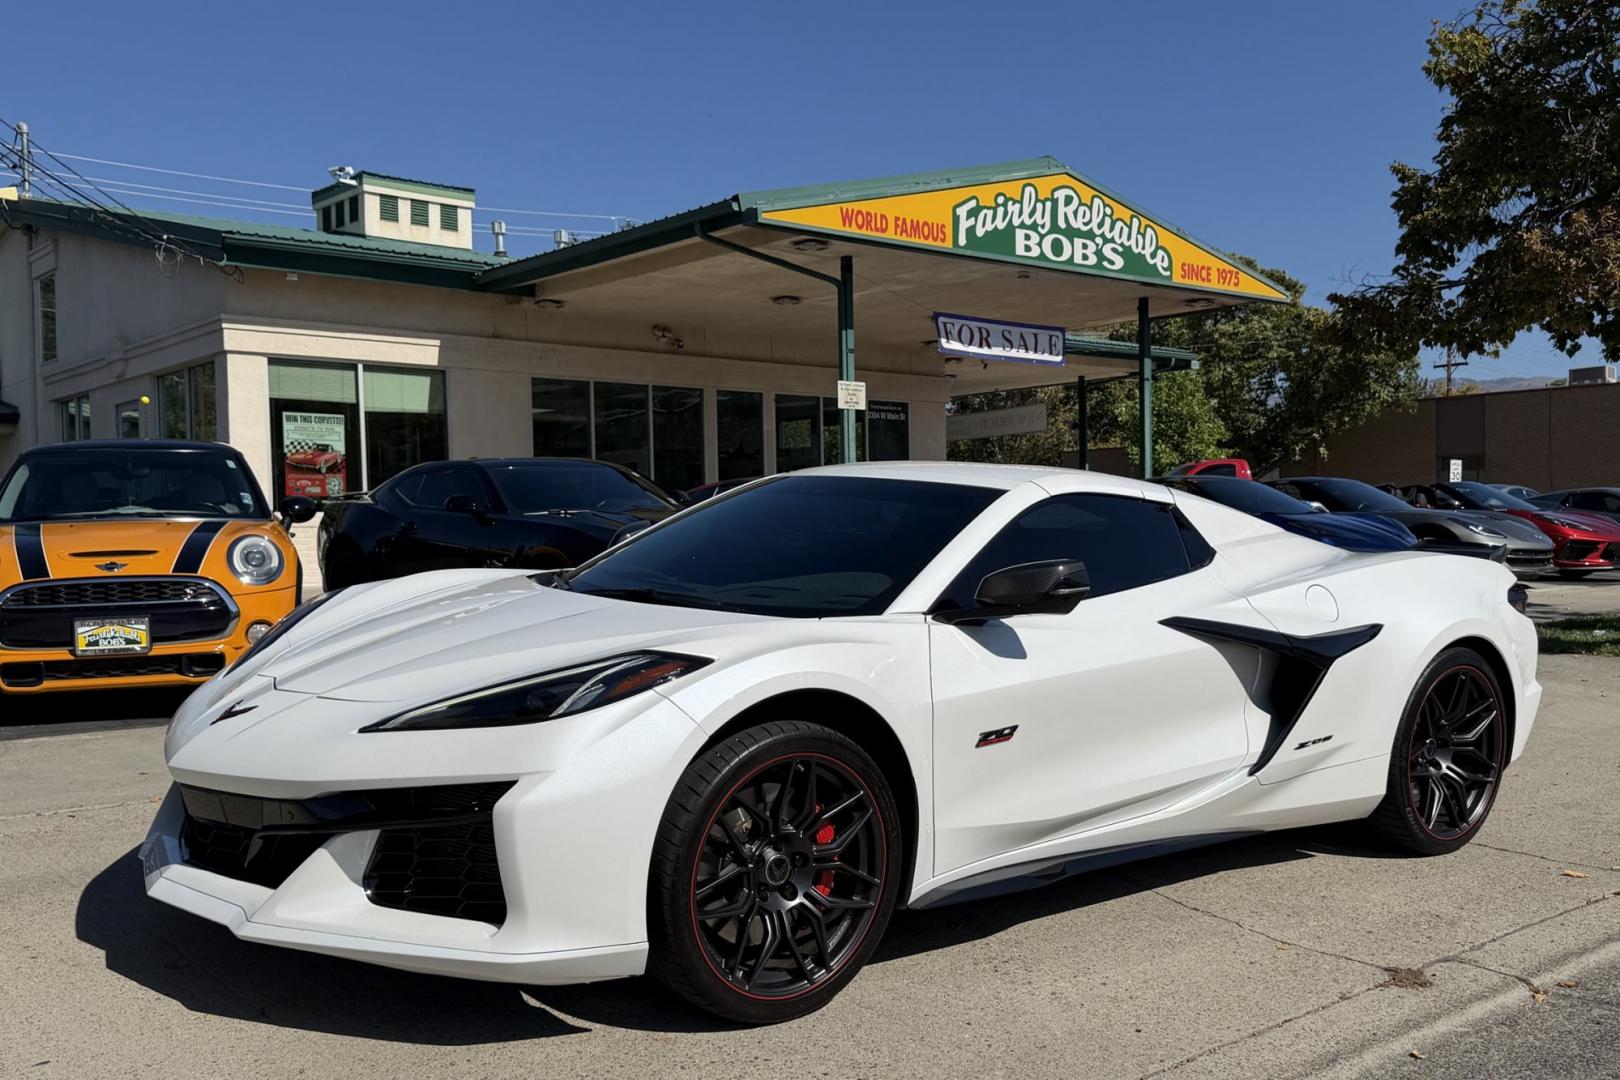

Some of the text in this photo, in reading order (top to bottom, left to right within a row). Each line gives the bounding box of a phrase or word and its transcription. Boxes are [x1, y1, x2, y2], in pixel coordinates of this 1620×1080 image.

[840, 206, 946, 243] WORLD FAMOUS
[956, 186, 1171, 276] Fairly Reliable
[1015, 228, 1125, 270] BOB'S
[1181, 262, 1240, 287] SINCE 1975
[942, 321, 1060, 356] FOR SALE
[285, 414, 298, 423] WIN
[300, 415, 312, 424] THIS
[1451, 471, 1460, 481] 30
